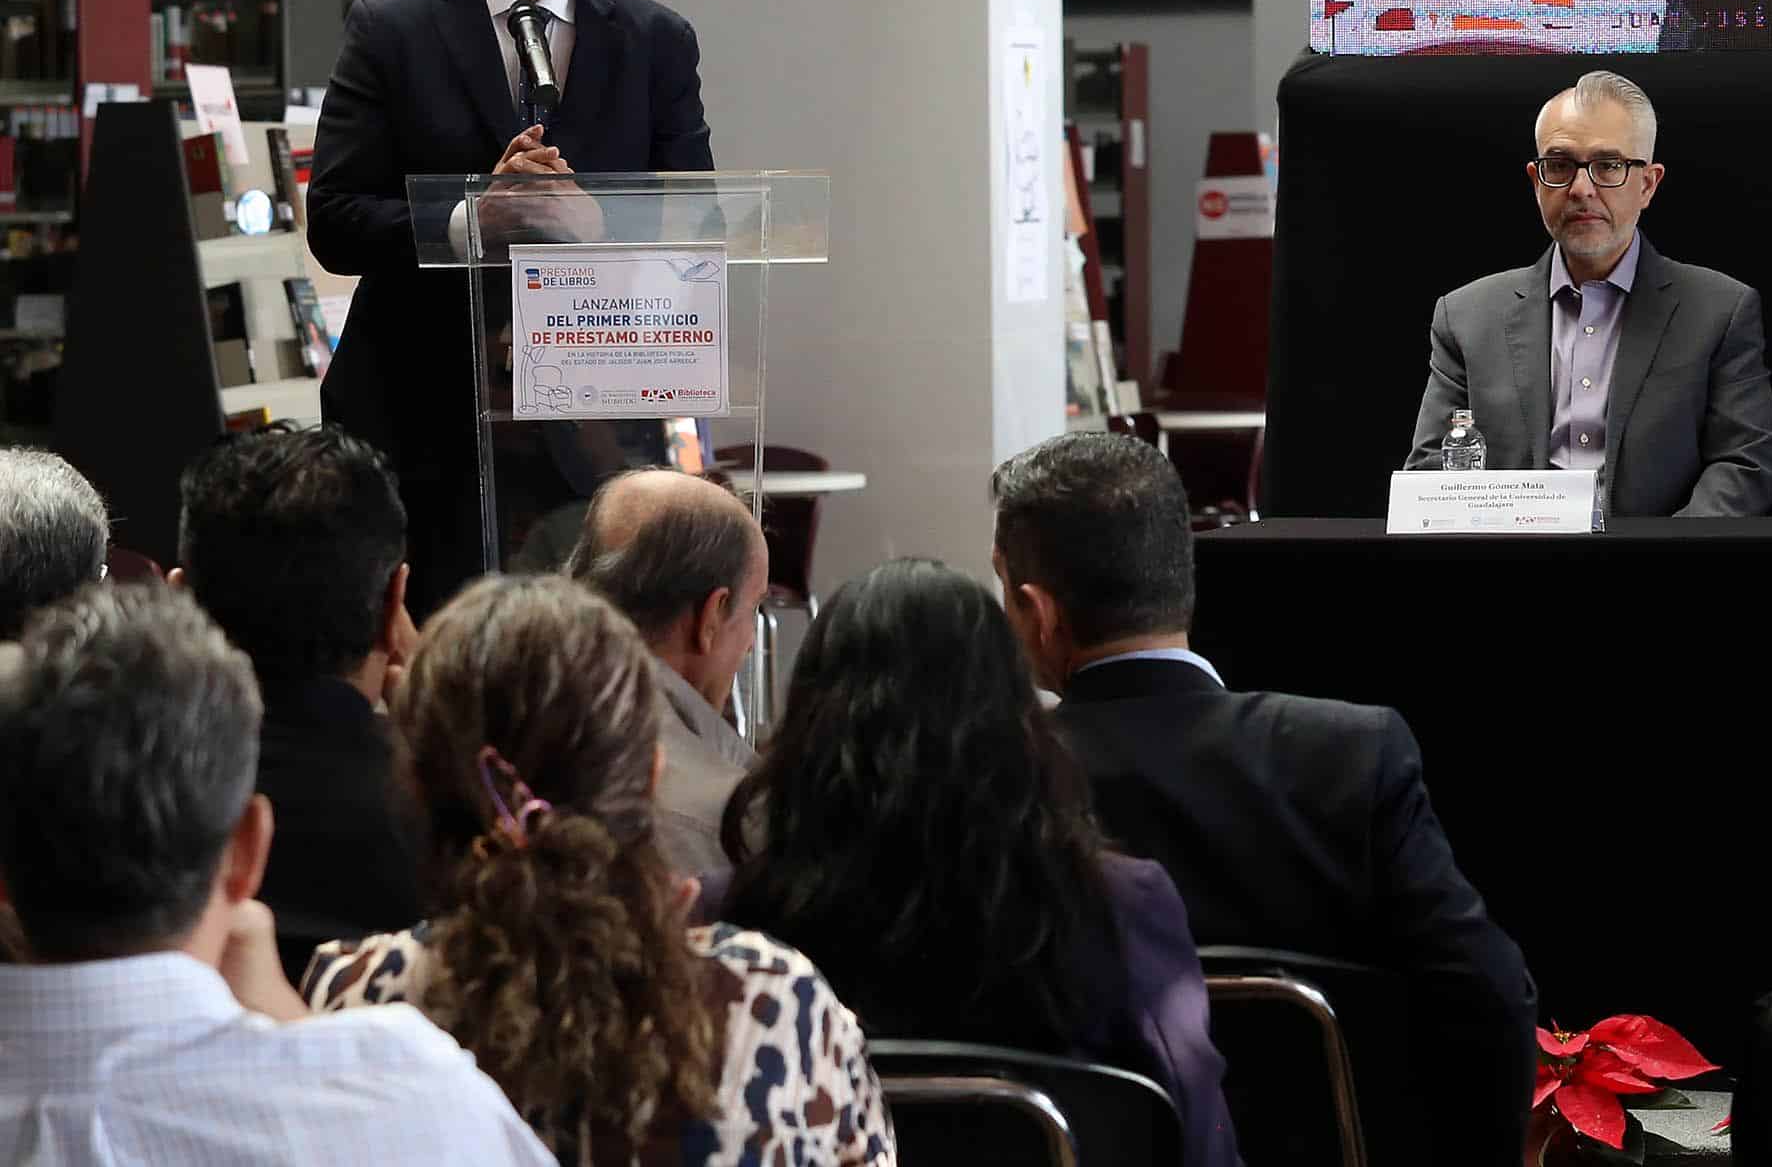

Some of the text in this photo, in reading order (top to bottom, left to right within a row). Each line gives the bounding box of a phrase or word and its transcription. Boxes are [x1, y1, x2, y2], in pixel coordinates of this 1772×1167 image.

[542, 276, 597, 286] DE LIBROS
[572, 298, 673, 310] LANZAMIENTO
[546, 314, 699, 327] DEL PRIMER SERVICIO
[531, 327, 714, 344] DE PRÉSTAMO EXTERNO
[1440, 482, 1487, 492] Guillermo
[1520, 482, 1546, 490] Mata
